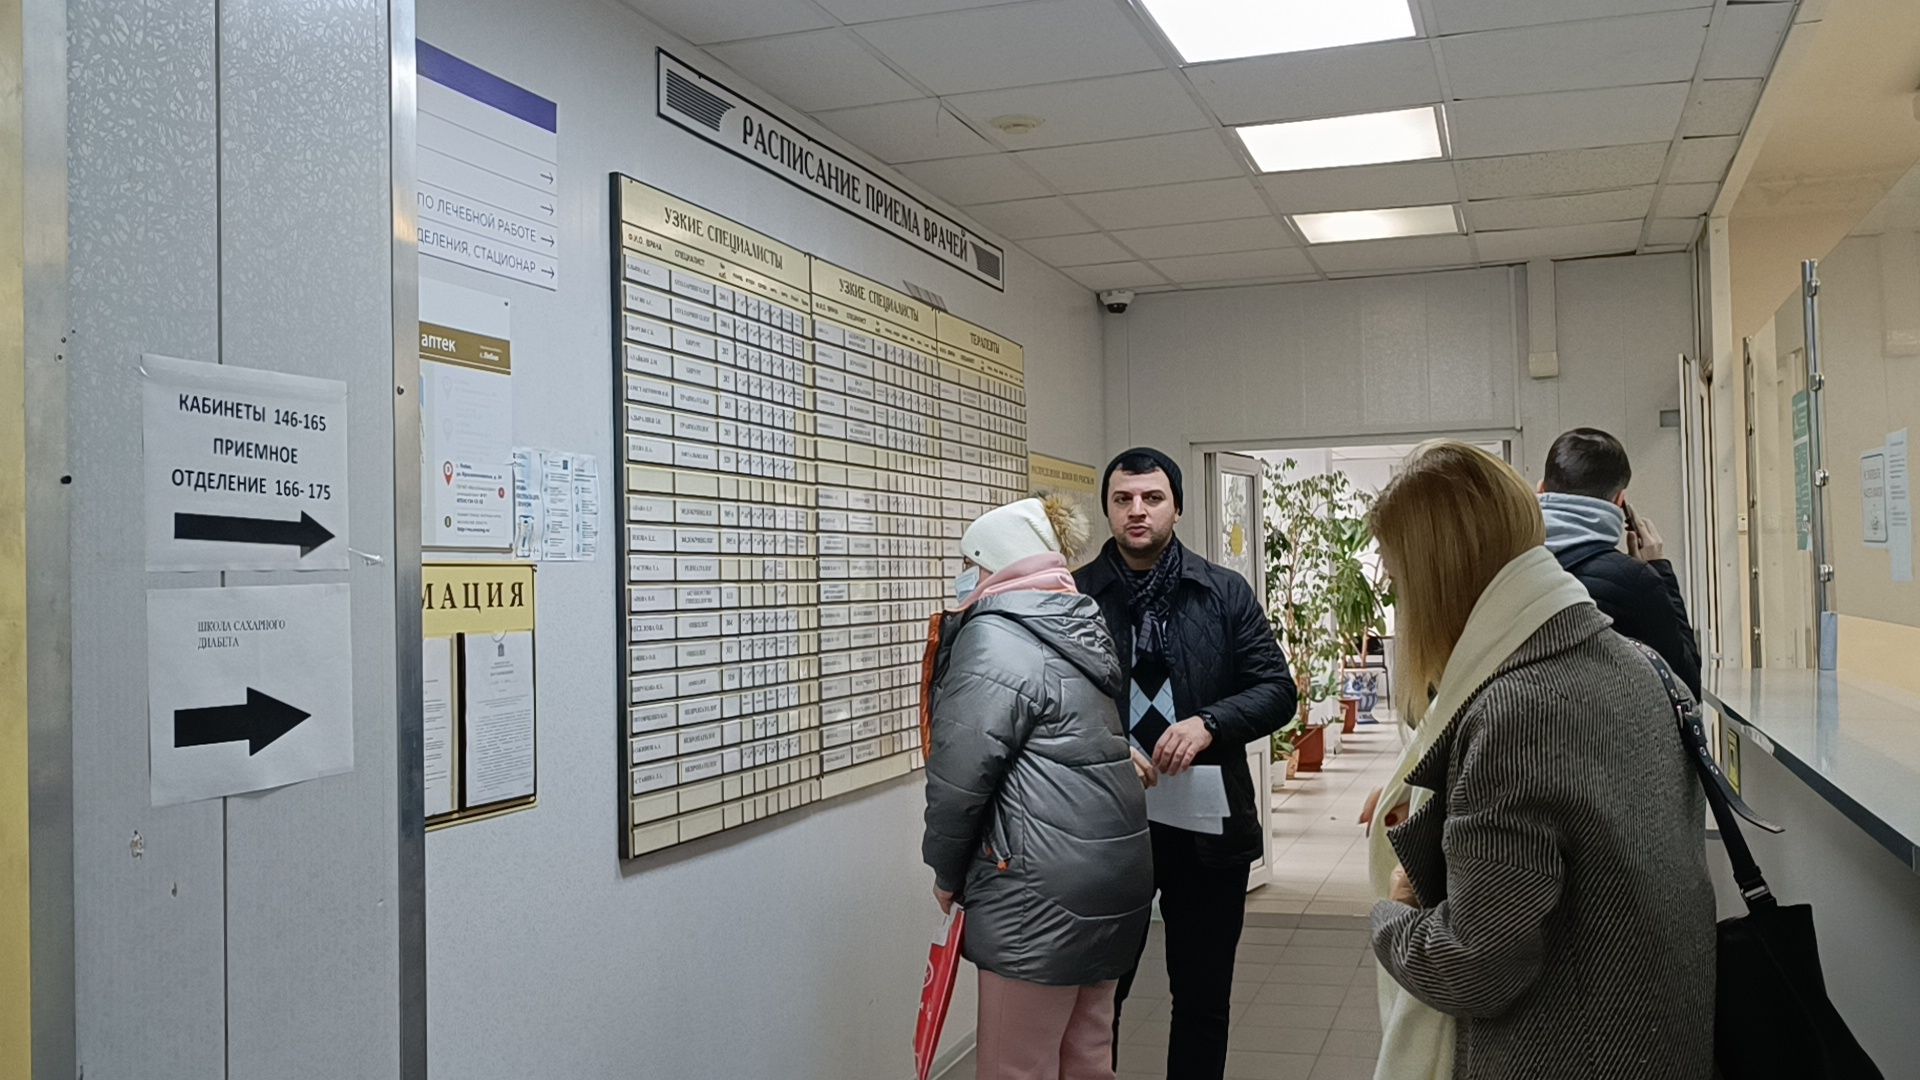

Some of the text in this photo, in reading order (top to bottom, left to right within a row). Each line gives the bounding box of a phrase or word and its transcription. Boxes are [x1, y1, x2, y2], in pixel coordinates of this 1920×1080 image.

[742, 115, 968, 263] РАСПИСАНИЕ ПРИЕМА ВРАЧЕЙ
[417, 191, 537, 242] ПО ЛЕЧЕБНОЙ РАБОТЕ
[664, 207, 783, 270] УЗКИЕ СПЕЦИАЛИСТЫ
[473, 245, 536, 272] СТАЦИОНАР
[838, 278, 866, 302] УЗКИЕ
[868, 290, 920, 323] СПЕЦИАЛИСТЫ
[421, 334, 456, 352] аптек
[179, 393, 327, 431] КАБИНЕТЫ 146-165
[213, 437, 298, 464] ПРИЕМНОЕ
[172, 468, 267, 494] ОТДЕЛЕНИЕ
[308, 483, 331, 500] 175
[198, 619, 286, 632] ШКОЛА САХАРНОГО
[197, 636, 240, 650] ДИАБЕТА
